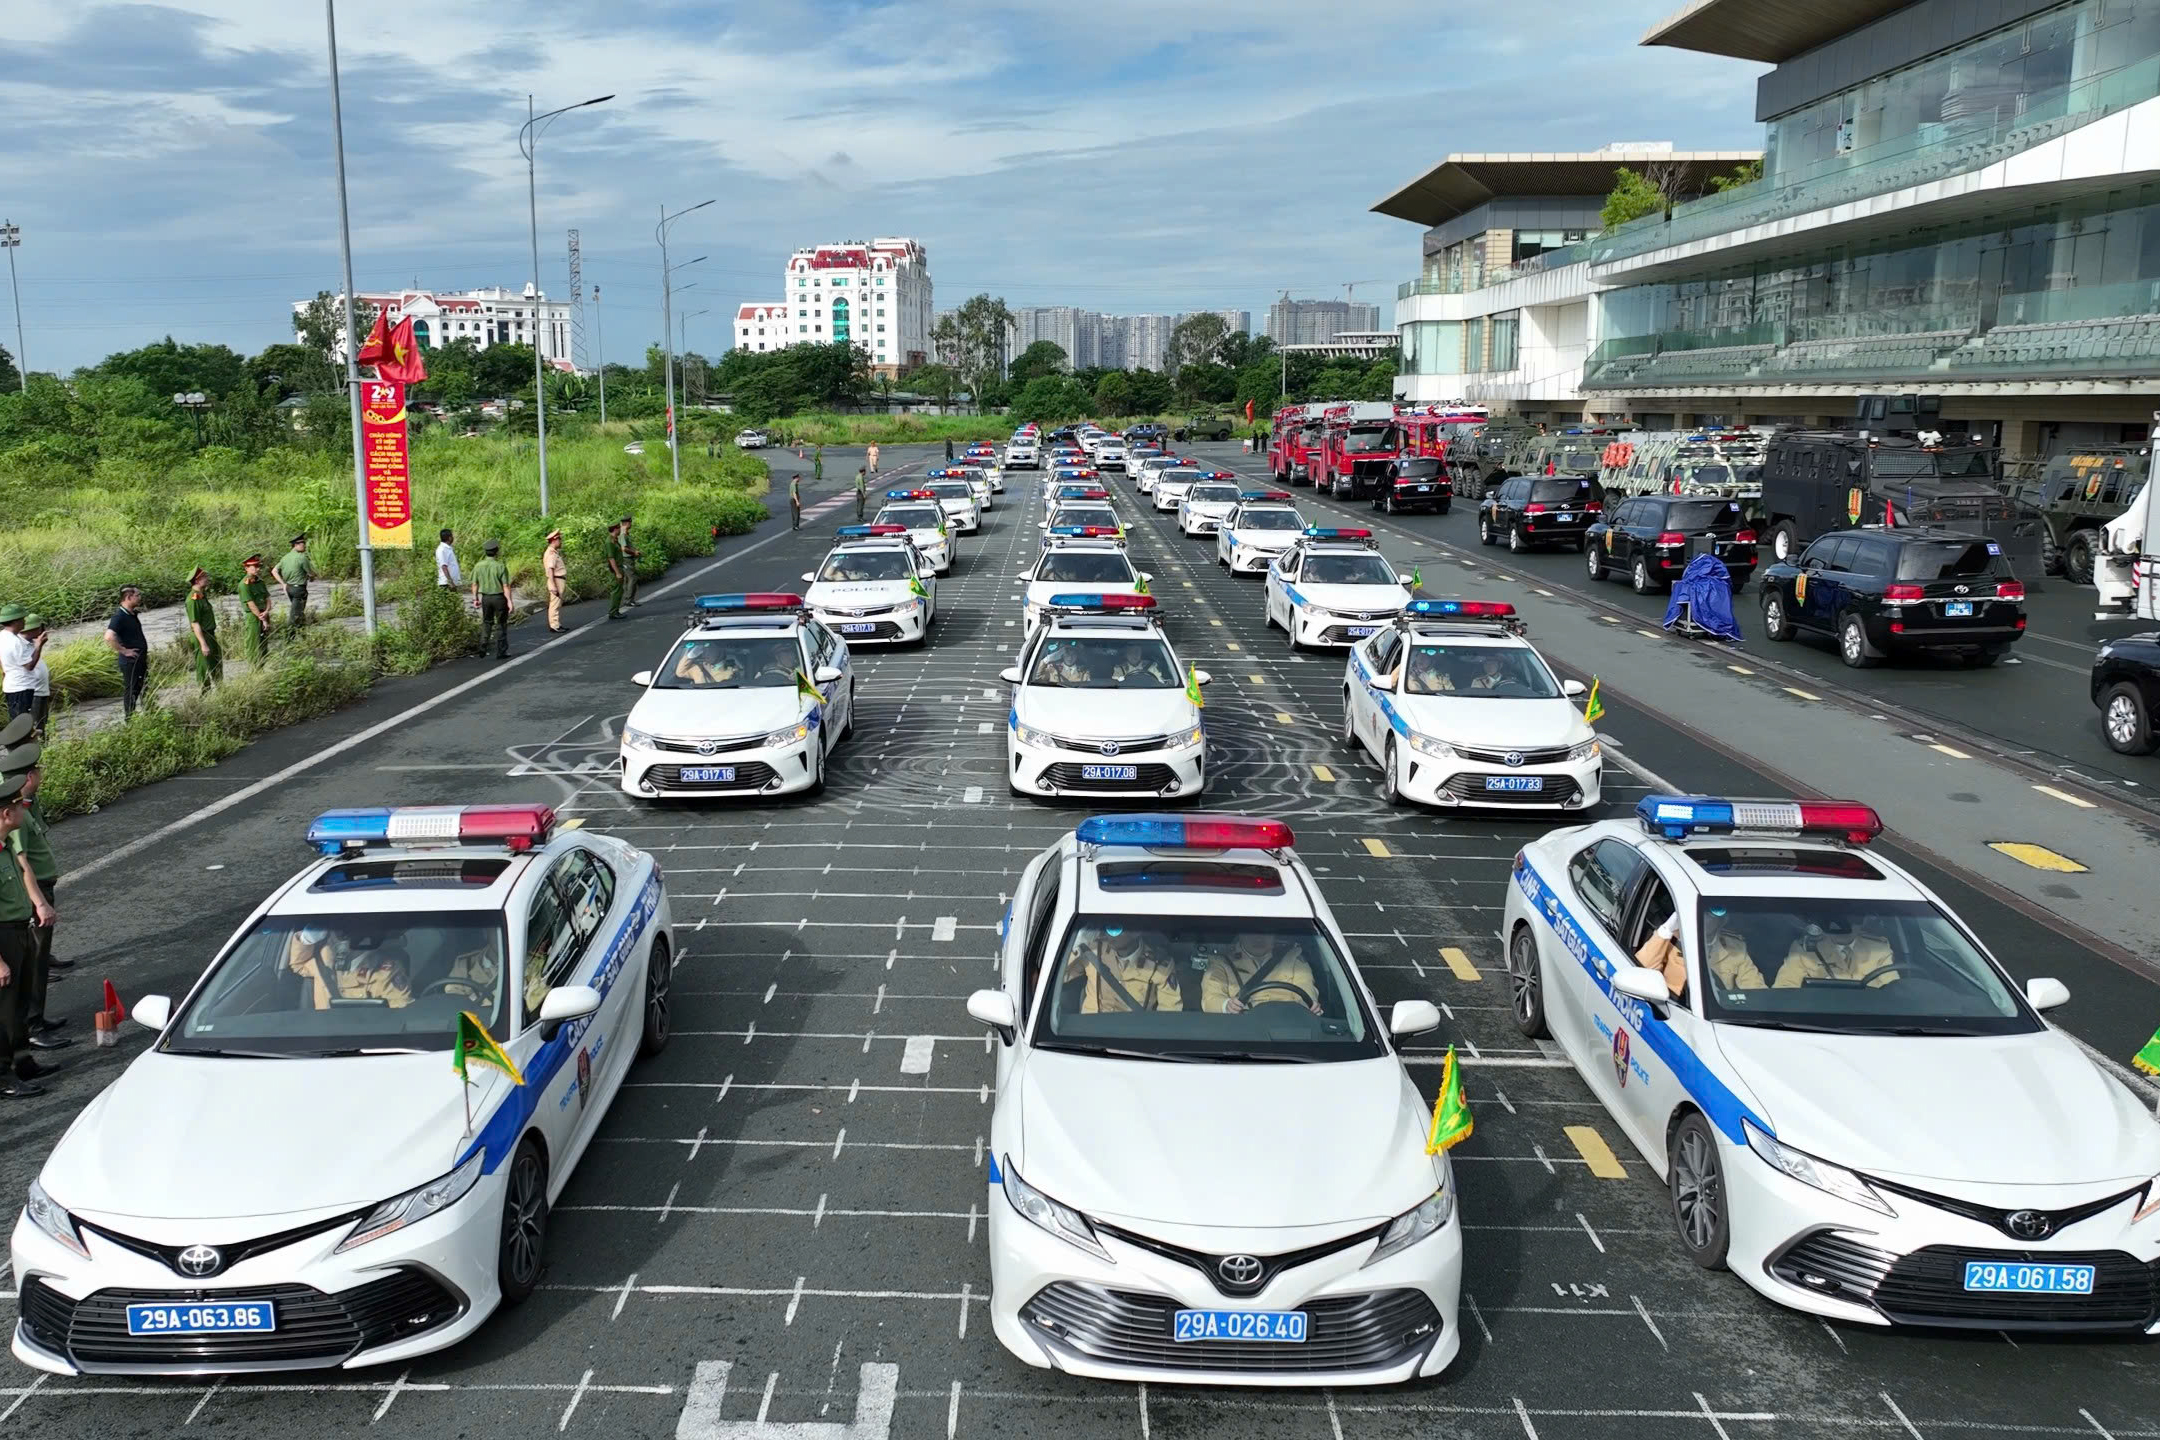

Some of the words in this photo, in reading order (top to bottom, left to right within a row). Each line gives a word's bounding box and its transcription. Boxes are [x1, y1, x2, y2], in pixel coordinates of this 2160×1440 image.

[682, 769, 733, 780] 29A-017.16
[1084, 767, 1135, 778] 29A-017.08
[1968, 1266, 2090, 1291] 29A-061.58
[140, 1307, 262, 1330] 29A-063.86
[1178, 1313, 1303, 1339] 29A-026.40
